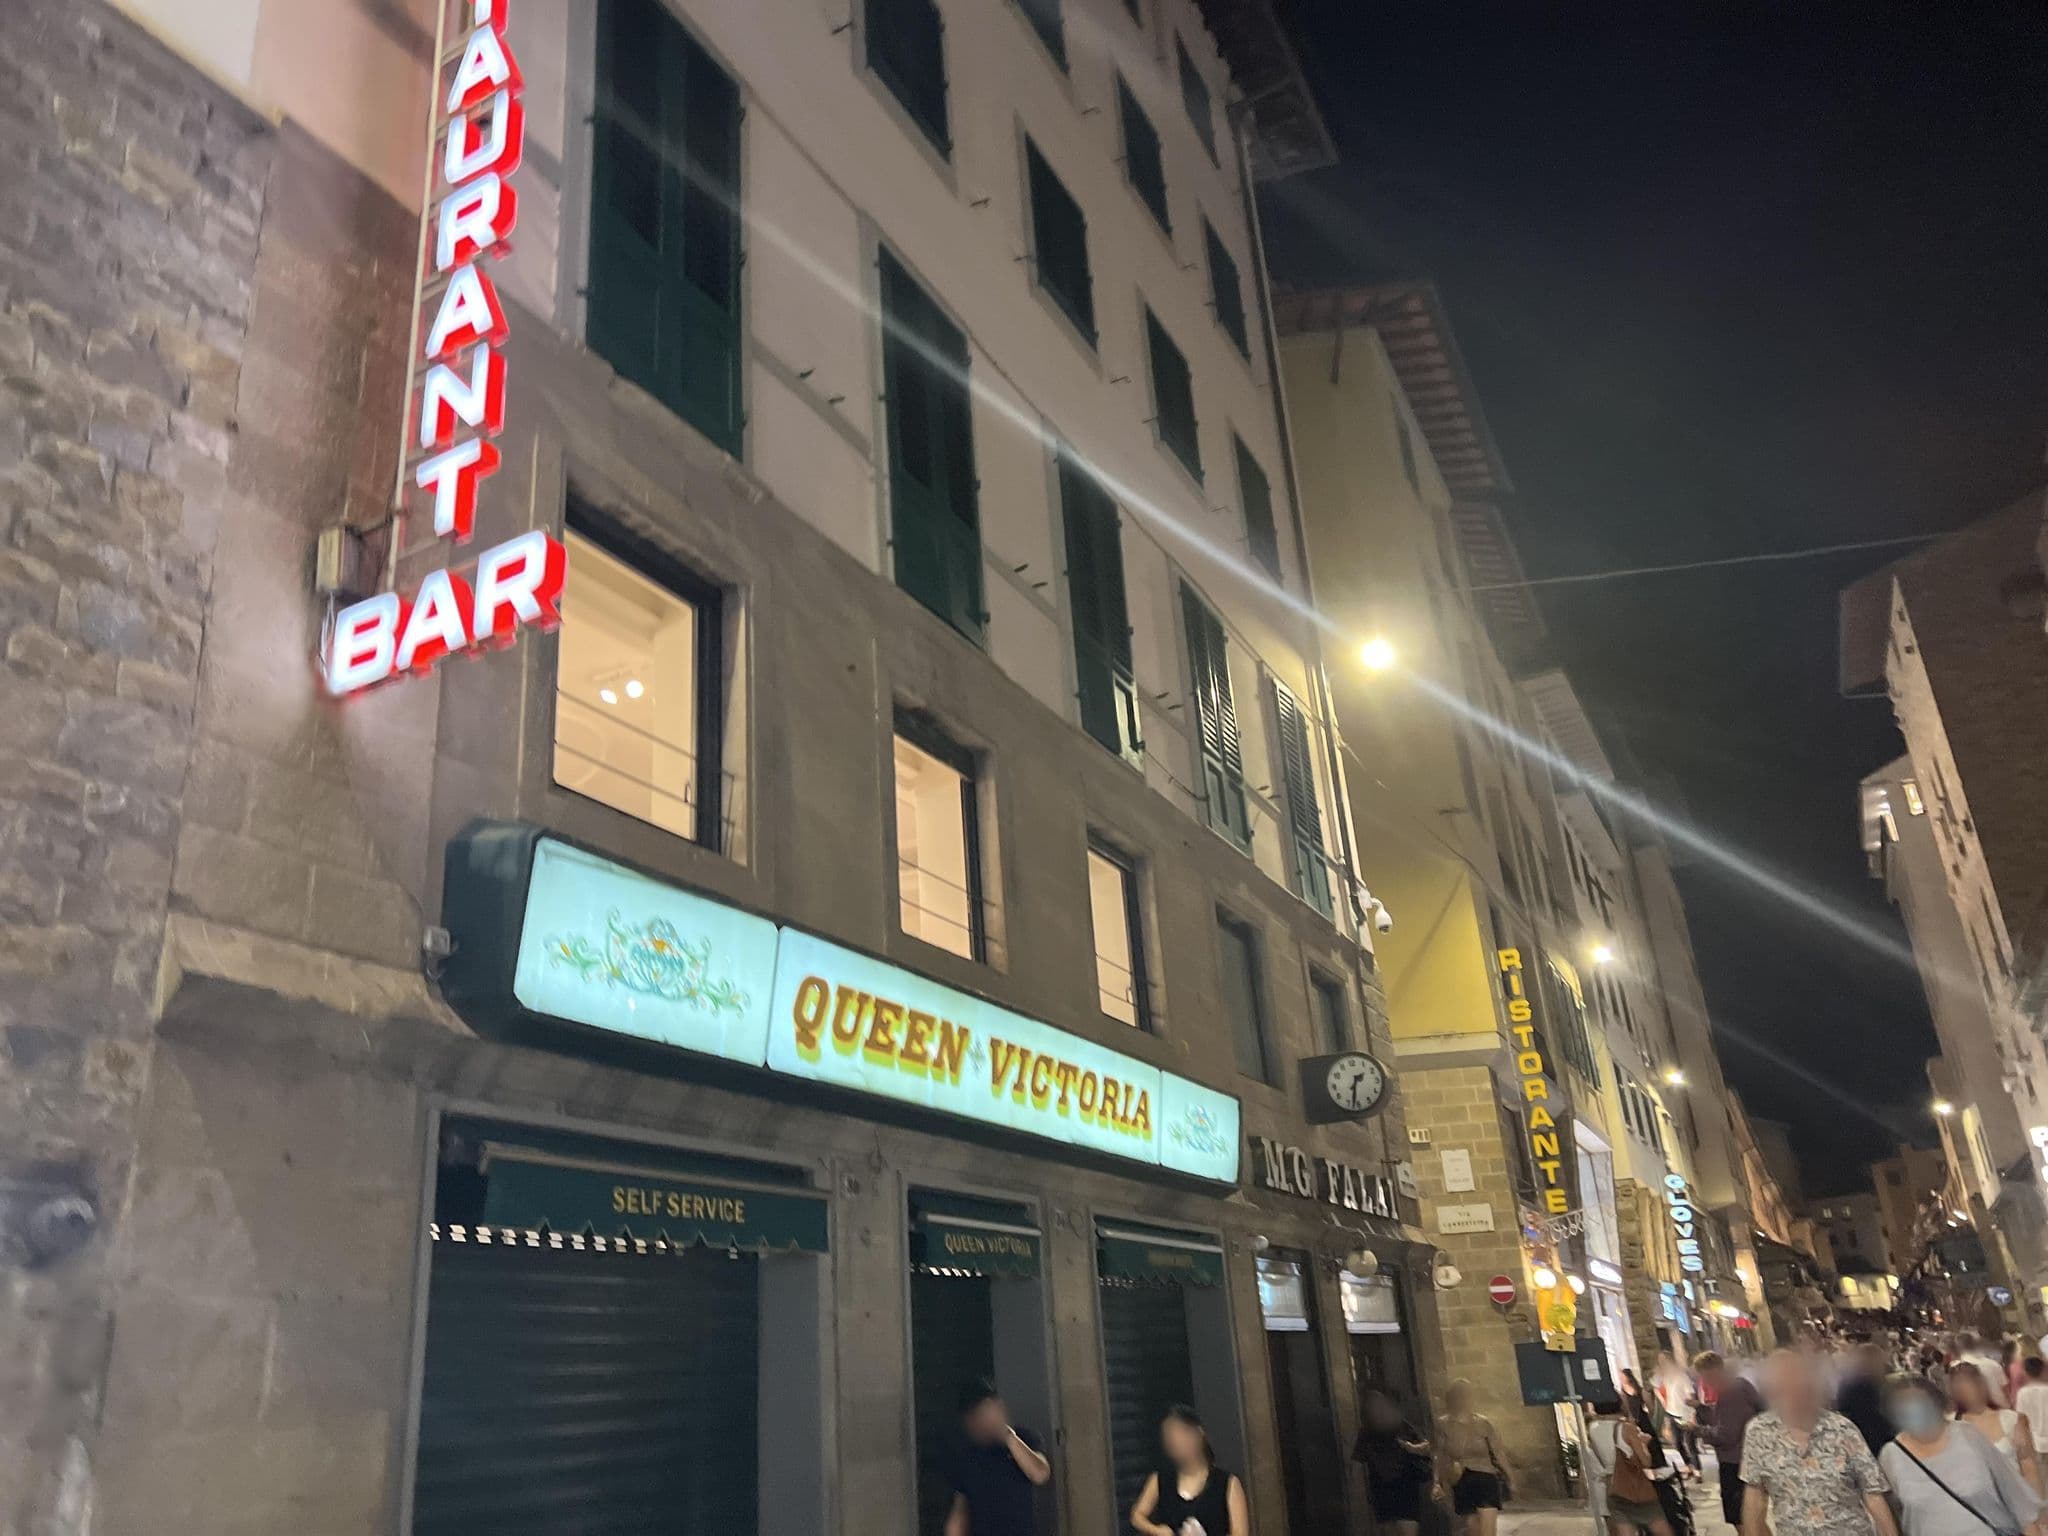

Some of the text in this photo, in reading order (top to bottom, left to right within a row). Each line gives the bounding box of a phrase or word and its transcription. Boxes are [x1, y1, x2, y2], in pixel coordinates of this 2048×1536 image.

[417, 0, 524, 542] AURANT
[327, 530, 567, 694] BAR
[793, 975, 1152, 1135] QUEEN VICTORIA
[1498, 947, 1568, 1213] RISTORANTE
[613, 1185, 745, 1223] SELF SERVICE
[944, 1232, 1032, 1258] QUEEN VICTORIA
[1664, 1174, 1703, 1271] GLOVES
